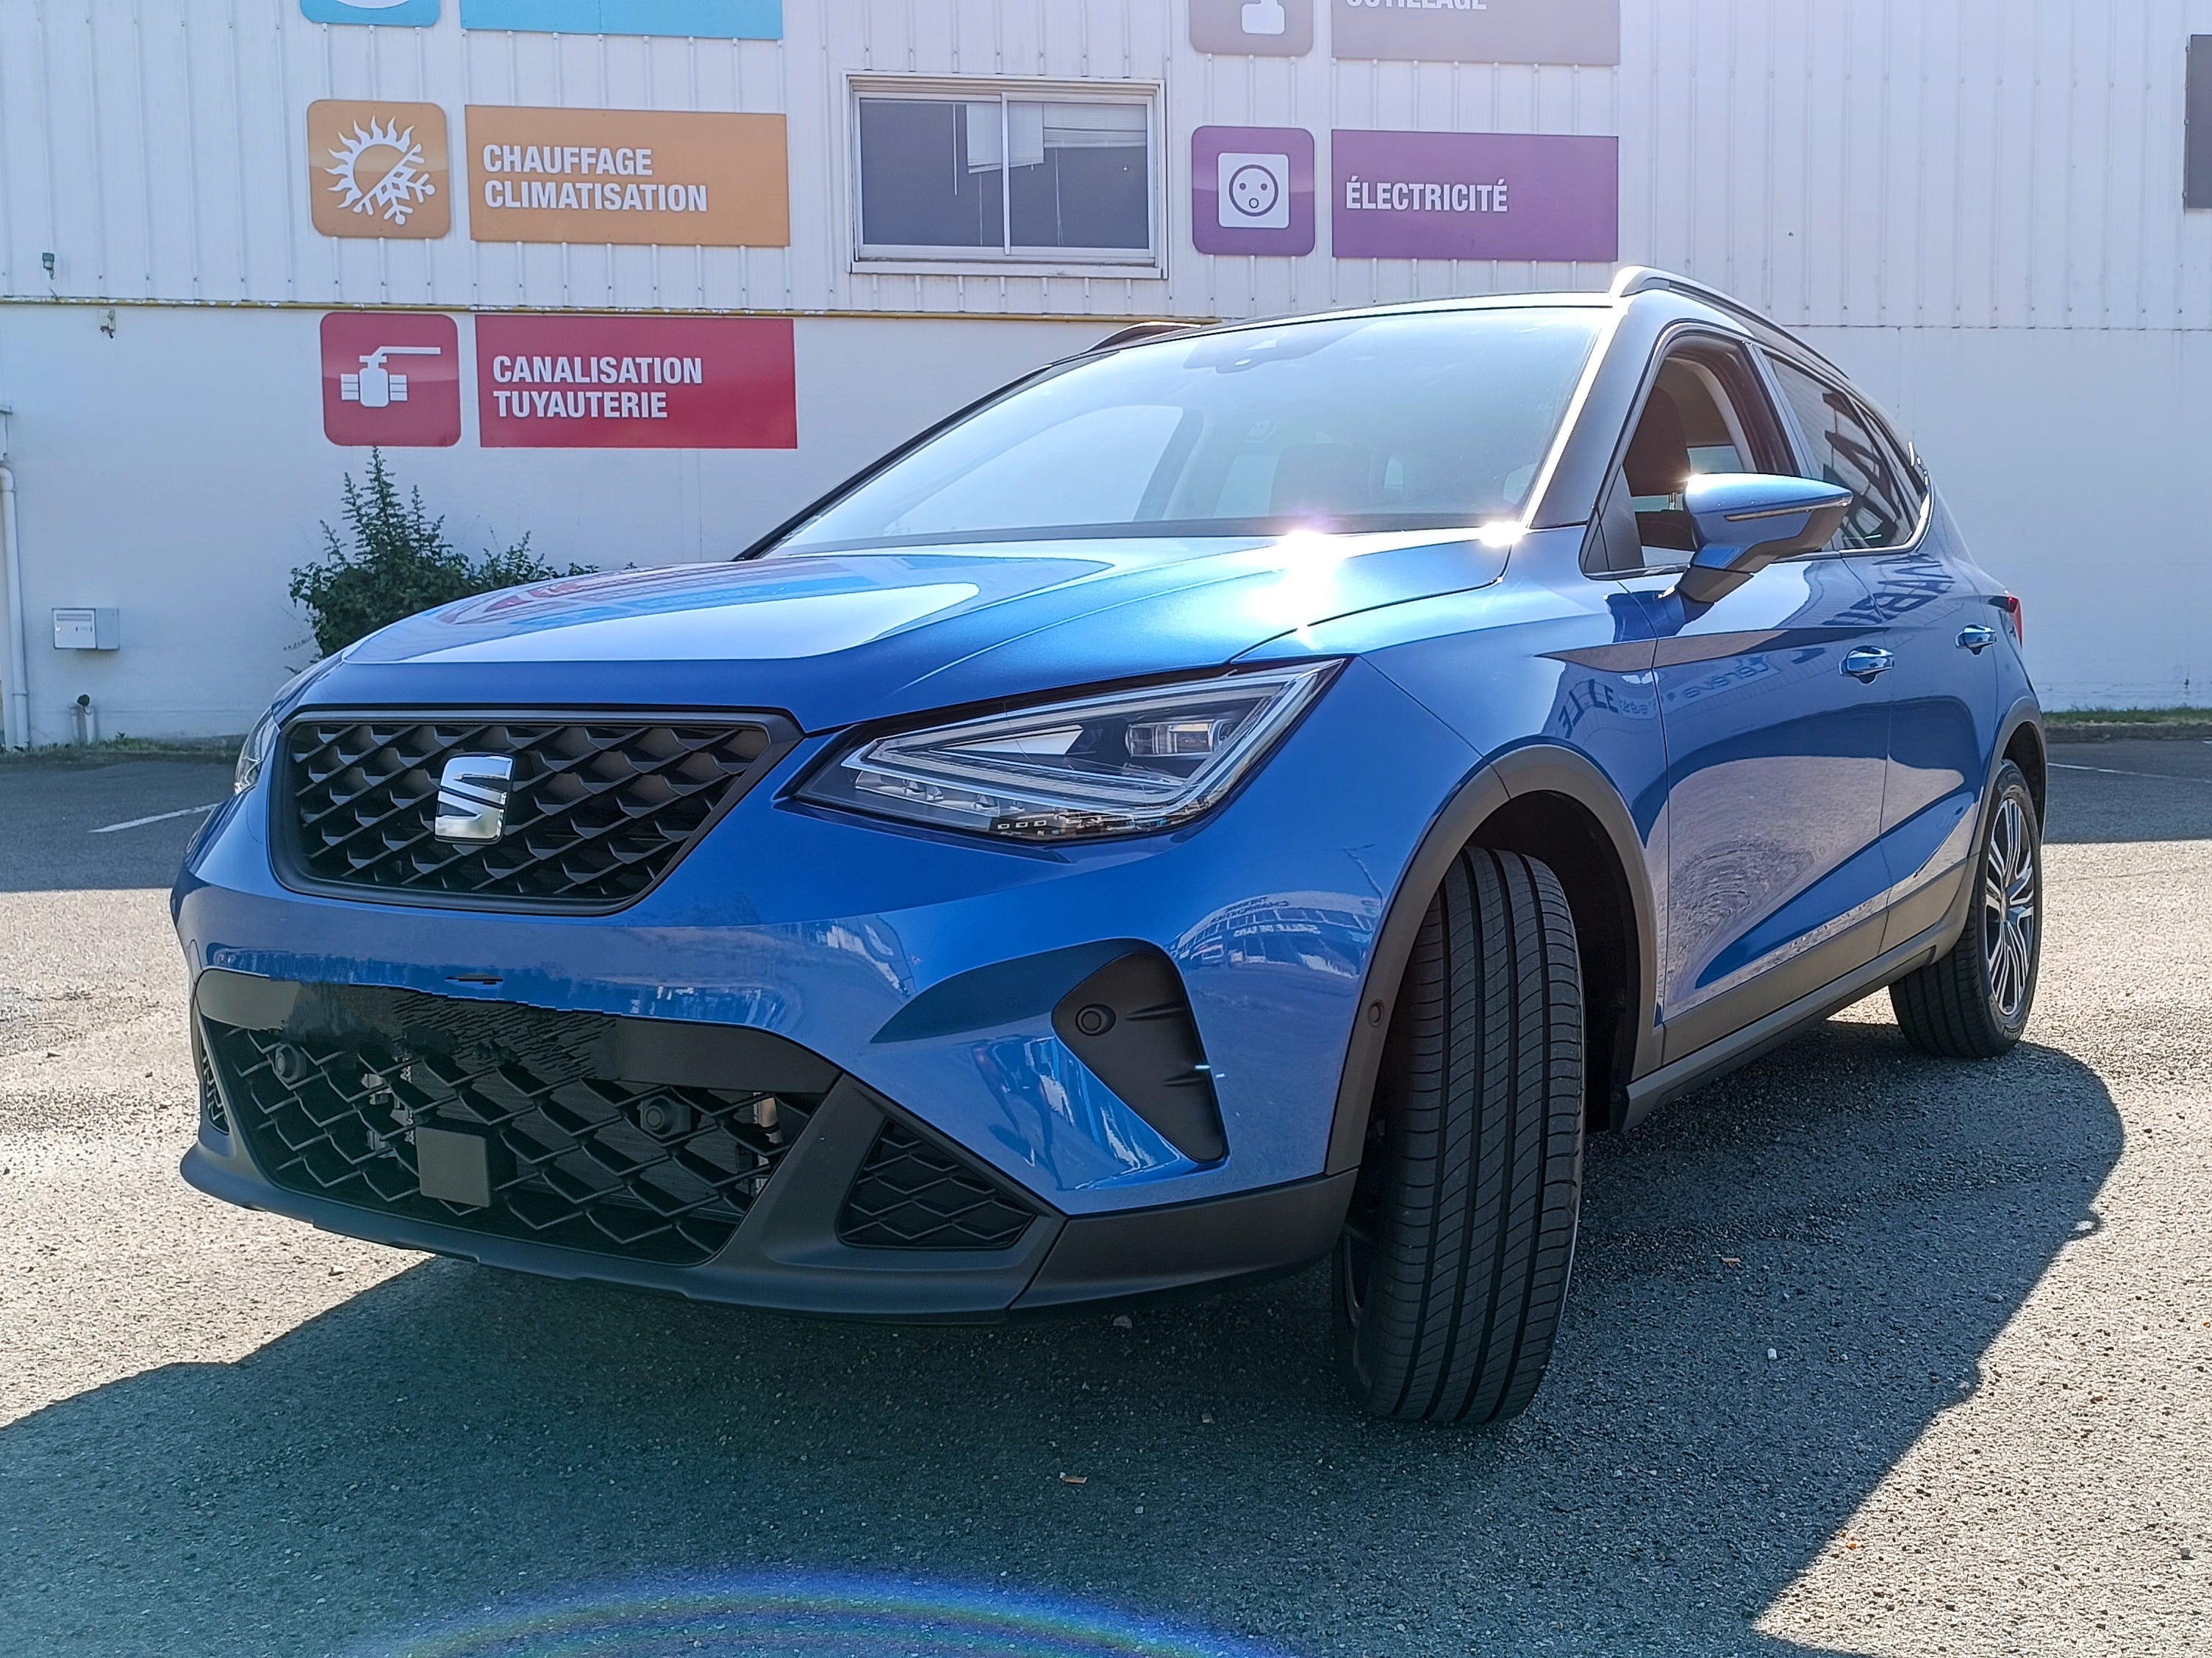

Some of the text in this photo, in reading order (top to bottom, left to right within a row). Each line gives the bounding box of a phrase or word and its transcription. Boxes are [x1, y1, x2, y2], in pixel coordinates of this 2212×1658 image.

[483, 144, 653, 176] CHAUFFAGE
[484, 180, 707, 212] CLIMATISATION
[1346, 175, 1508, 212] ÉLECTRICITÉ
[493, 356, 702, 384] CANALISATION
[493, 390, 667, 418] TUYAUTERIE
